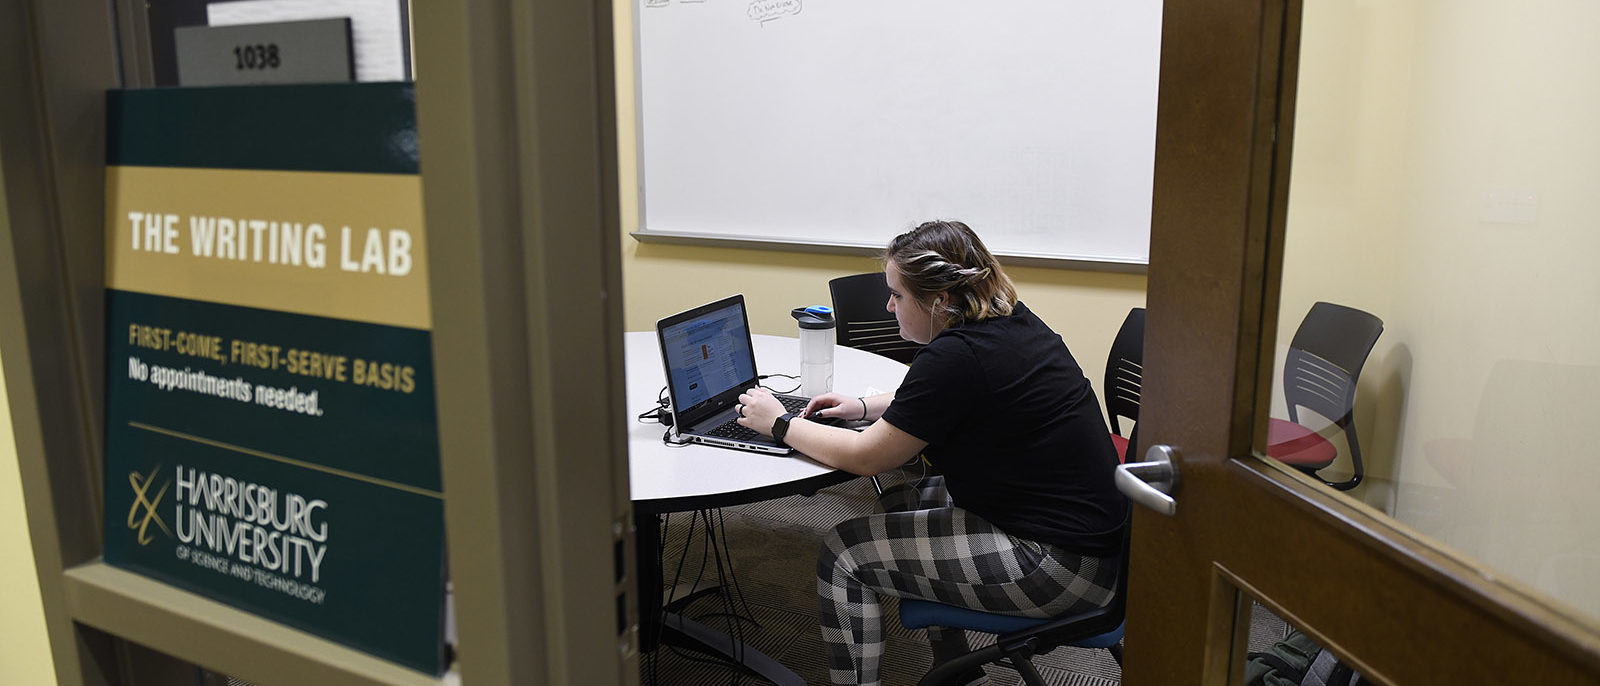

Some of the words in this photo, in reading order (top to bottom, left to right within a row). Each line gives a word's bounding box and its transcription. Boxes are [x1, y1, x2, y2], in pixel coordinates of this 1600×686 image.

[233, 44, 281, 70] 1038
[128, 211, 180, 254] THE
[190, 216, 326, 268] WRITING
[340, 226, 412, 276] LAB
[128, 323, 228, 365] FIRST-COME,
[231, 340, 347, 382] FIRST-SERVE
[353, 359, 415, 393] BASIS
[128, 357, 148, 381] No
[150, 365, 253, 402] appointments
[255, 384, 323, 416] needed.
[176, 464, 328, 542] HARRISBURG
[176, 504, 327, 583] UNIVERSITY
[176, 546, 190, 559] OF
[191, 551, 229, 574] SCIENCE
[230, 564, 253, 582] AND
[253, 569, 326, 604] TECHNOLOGY
